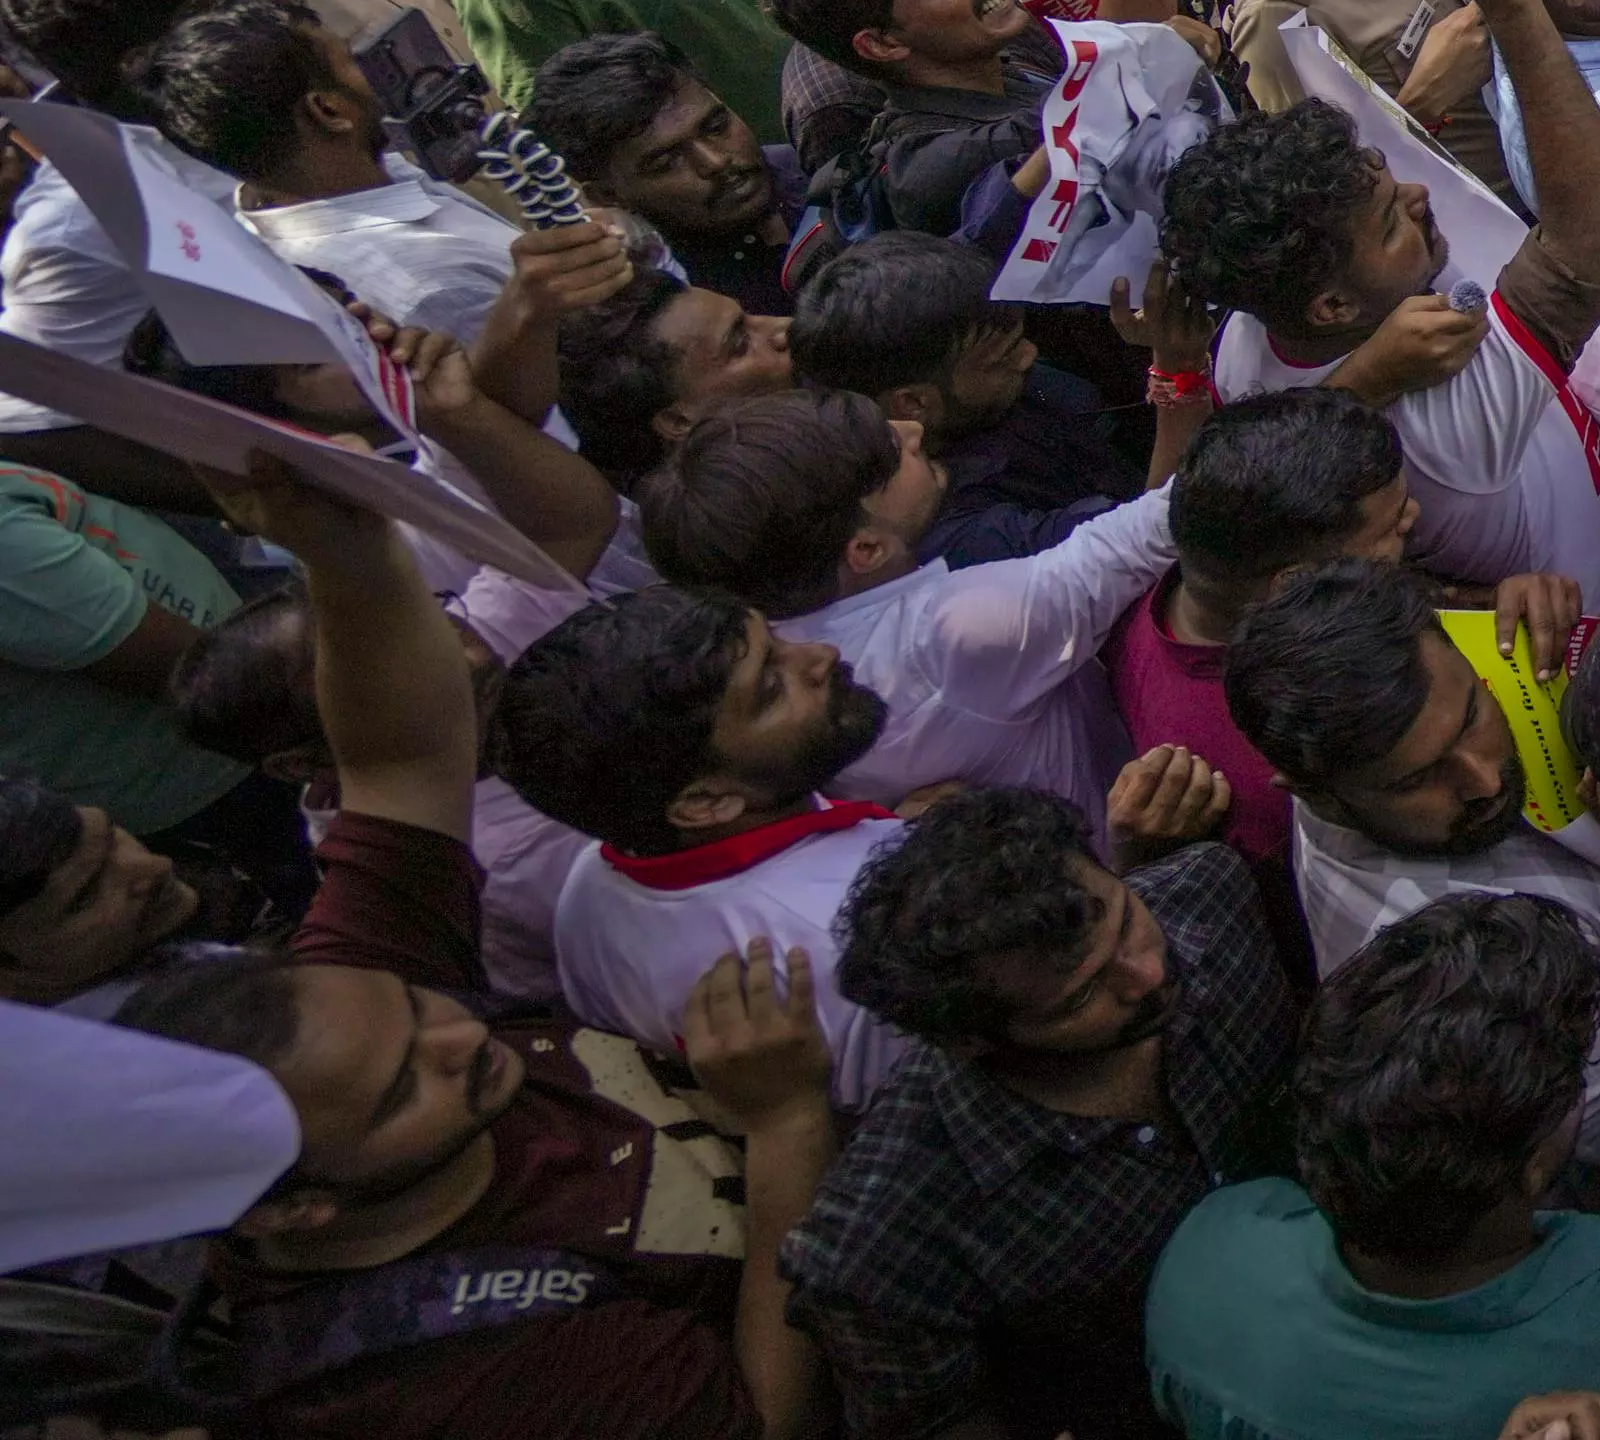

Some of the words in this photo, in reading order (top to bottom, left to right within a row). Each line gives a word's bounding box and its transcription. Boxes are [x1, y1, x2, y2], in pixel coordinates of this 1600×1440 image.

[1021, 40, 1098, 262] DYFI
[1516, 682, 1535, 712] for
[451, 1264, 596, 1315] safari
